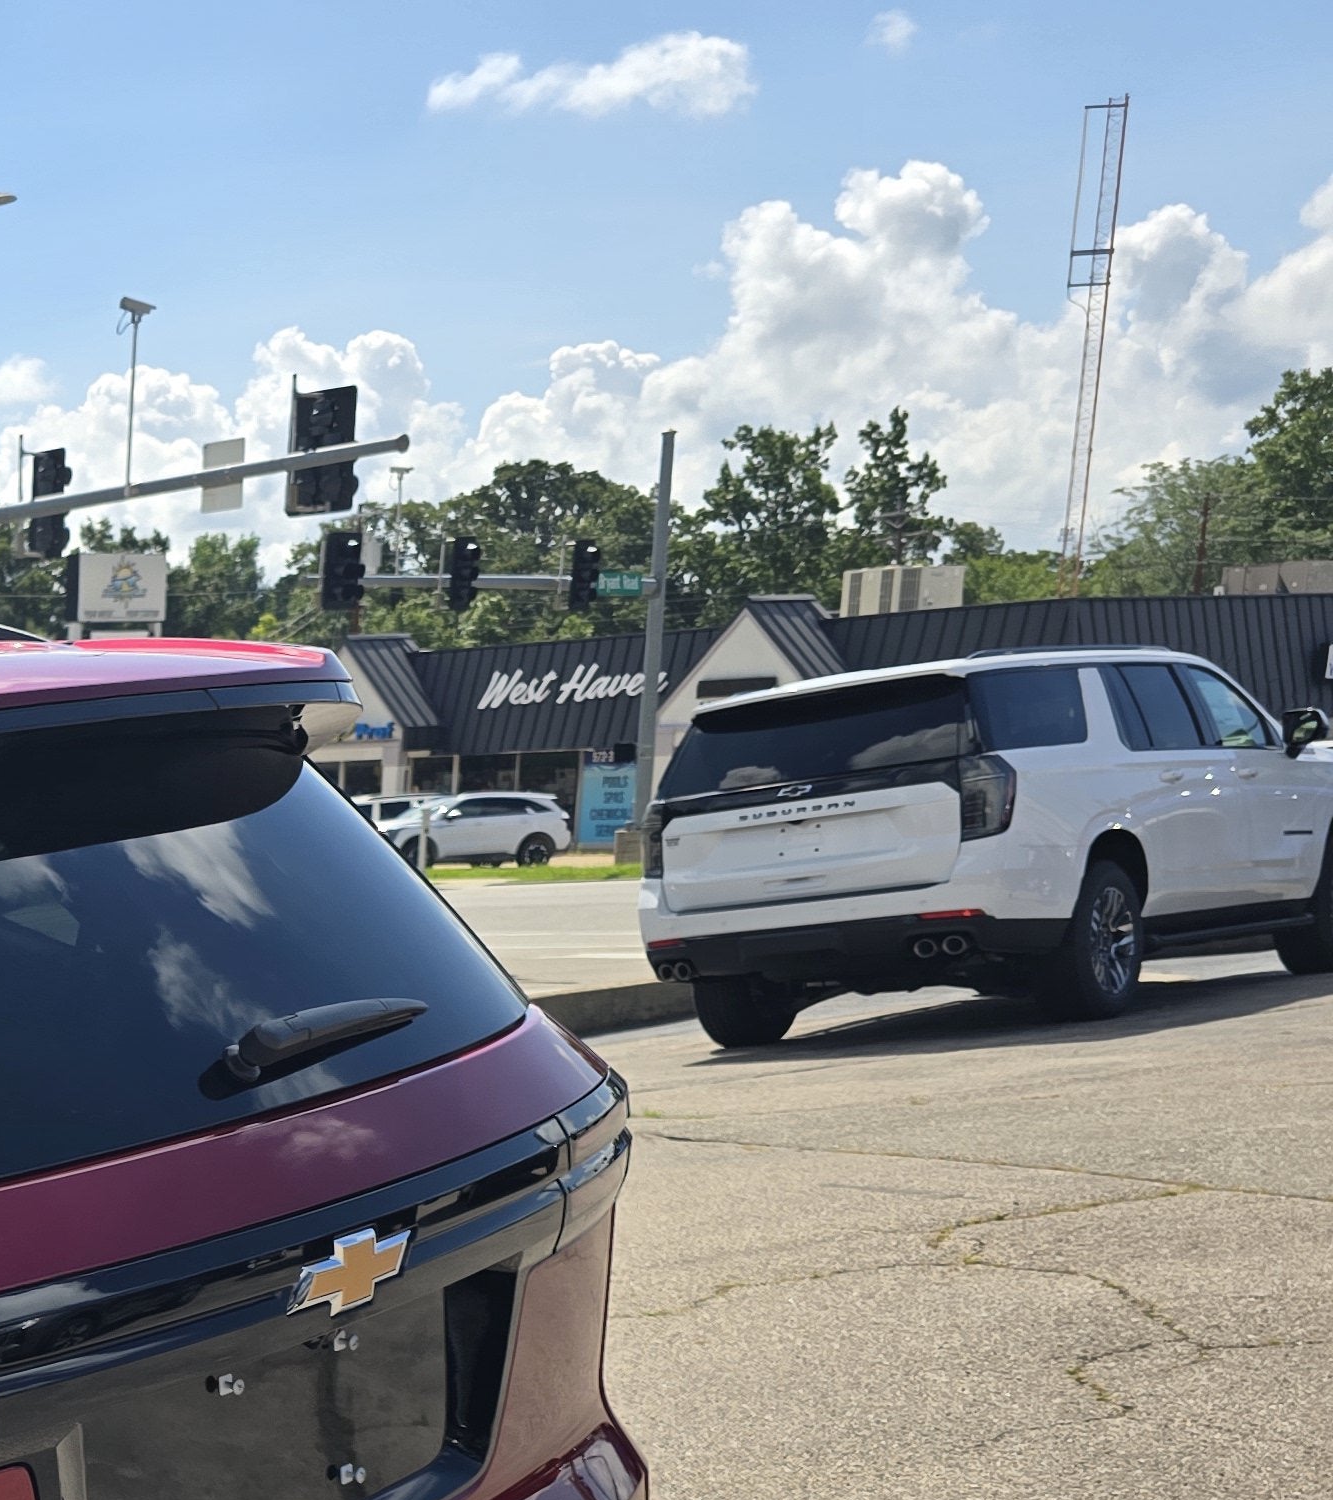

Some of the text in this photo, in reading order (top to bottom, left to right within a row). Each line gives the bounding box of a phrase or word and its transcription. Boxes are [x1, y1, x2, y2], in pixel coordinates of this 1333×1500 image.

[477, 668, 558, 709] West
[590, 808, 632, 821] CHEMICAL
[739, 800, 855, 821] SUBURBAN
